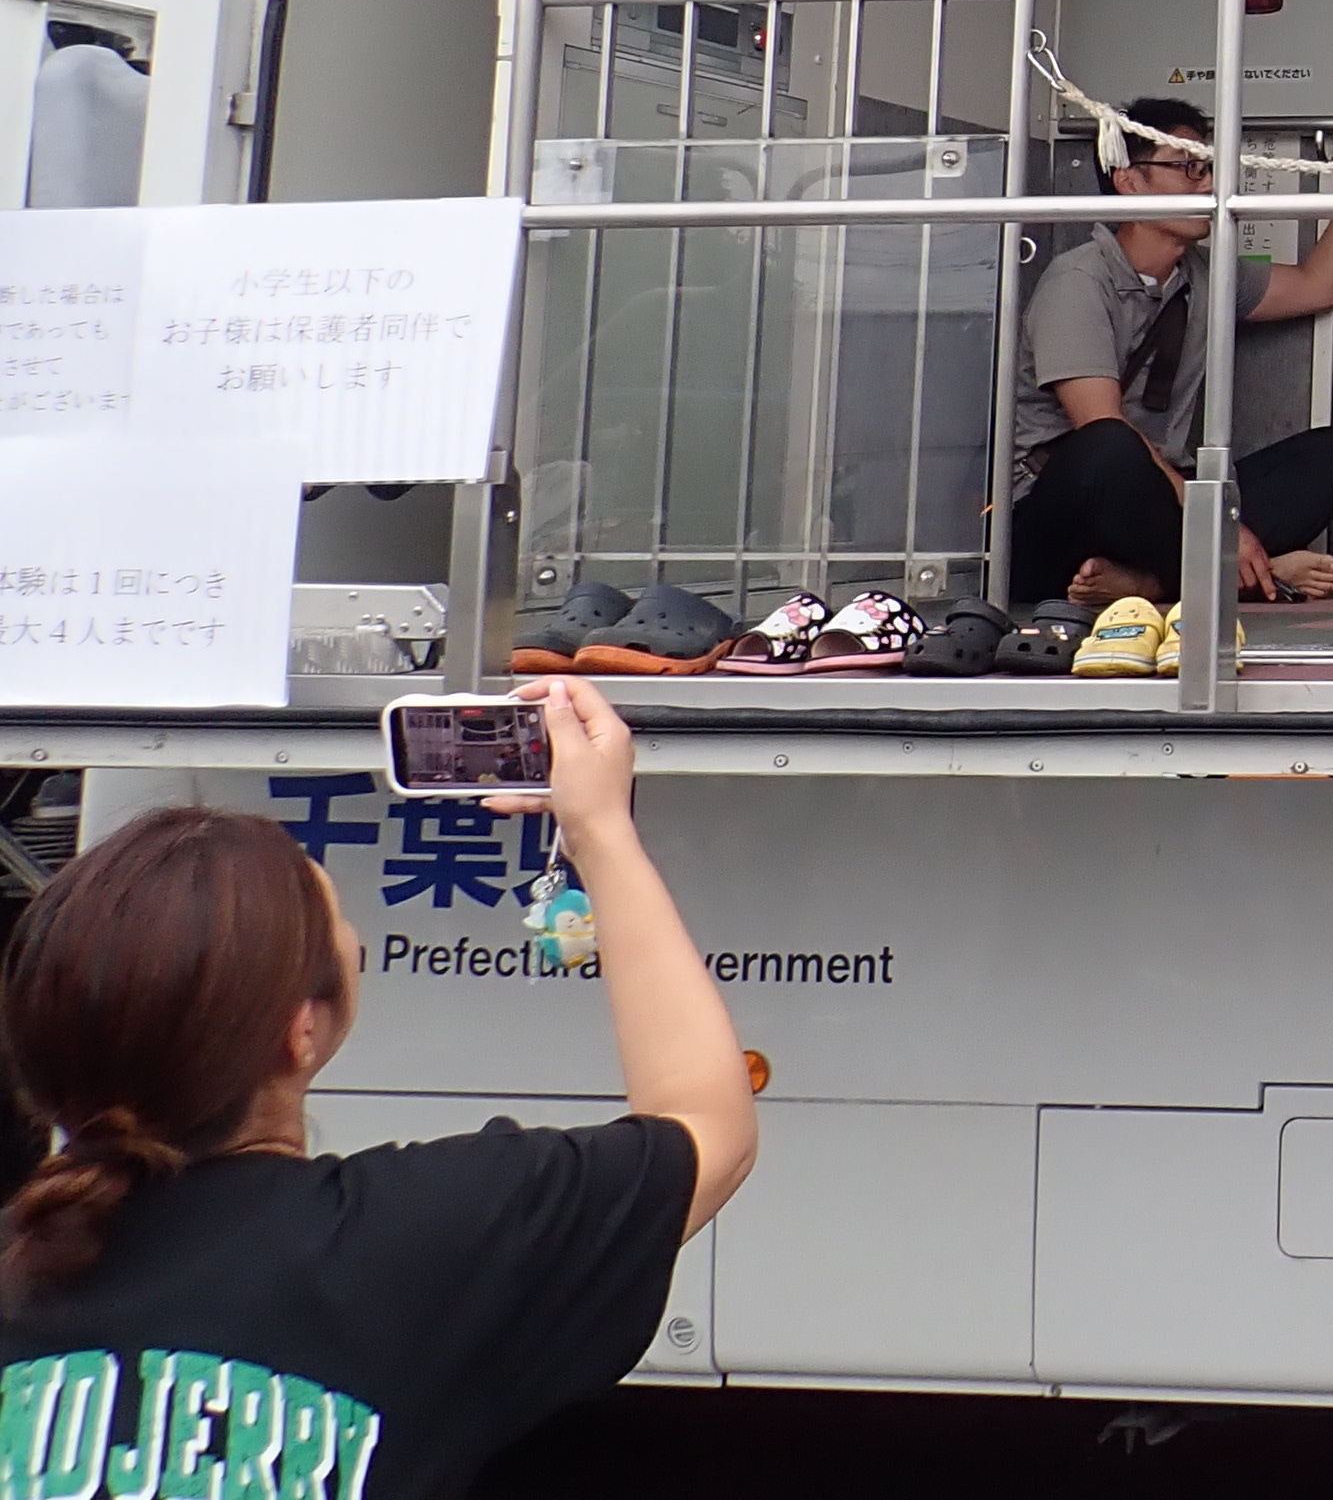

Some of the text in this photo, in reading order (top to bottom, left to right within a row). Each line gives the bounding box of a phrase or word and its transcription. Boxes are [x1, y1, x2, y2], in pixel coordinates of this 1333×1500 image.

[232, 266, 415, 297] 小学生以下の
[0, 319, 109, 341] であっても
[162, 311, 472, 345] お子様は保護者同伴で
[216, 361, 403, 391] お願いします
[0, 390, 130, 412] がございま
[383, 934, 602, 980] Prefectua
[702, 945, 895, 984] ernment
[107, 1348, 381, 1500] JERRY
